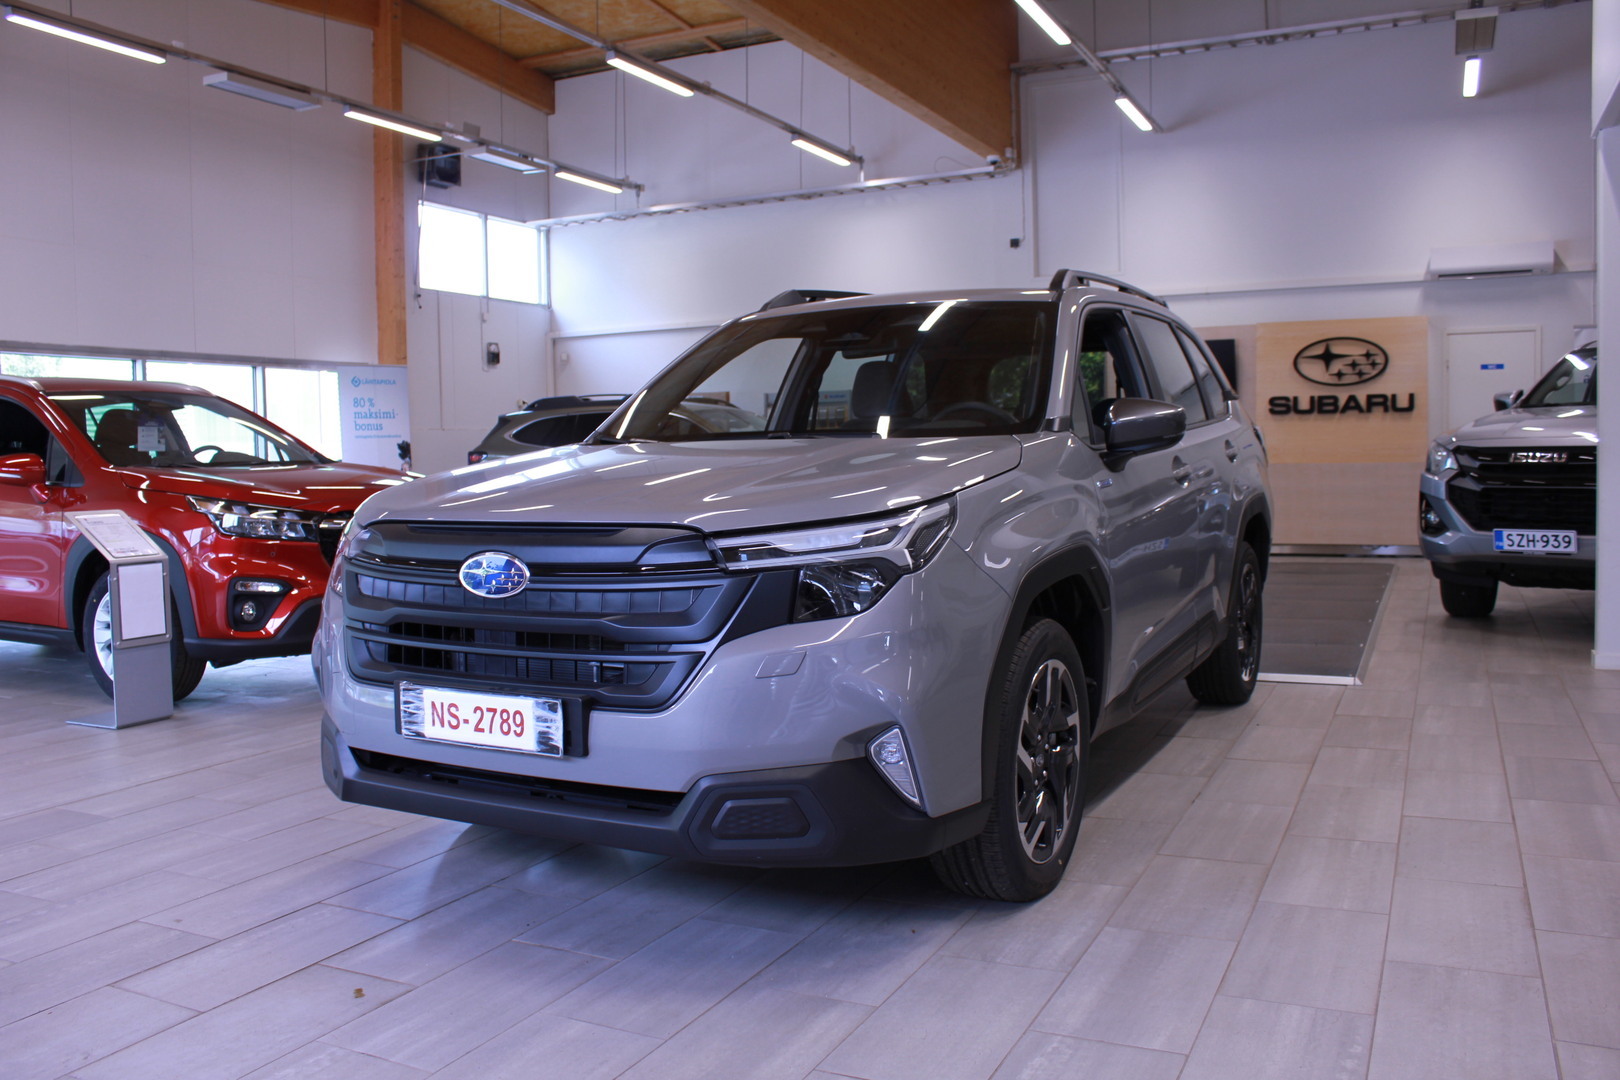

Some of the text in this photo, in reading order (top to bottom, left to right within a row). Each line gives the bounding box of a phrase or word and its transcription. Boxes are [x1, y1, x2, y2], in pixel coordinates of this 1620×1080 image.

[353, 397, 375, 408] 80 %
[1268, 393, 1415, 415] SUBARU
[354, 420, 384, 431] bonus
[1509, 452, 1568, 463] ISUZU
[1506, 533, 1572, 549] SZH-939
[430, 700, 525, 738] NS-2789
